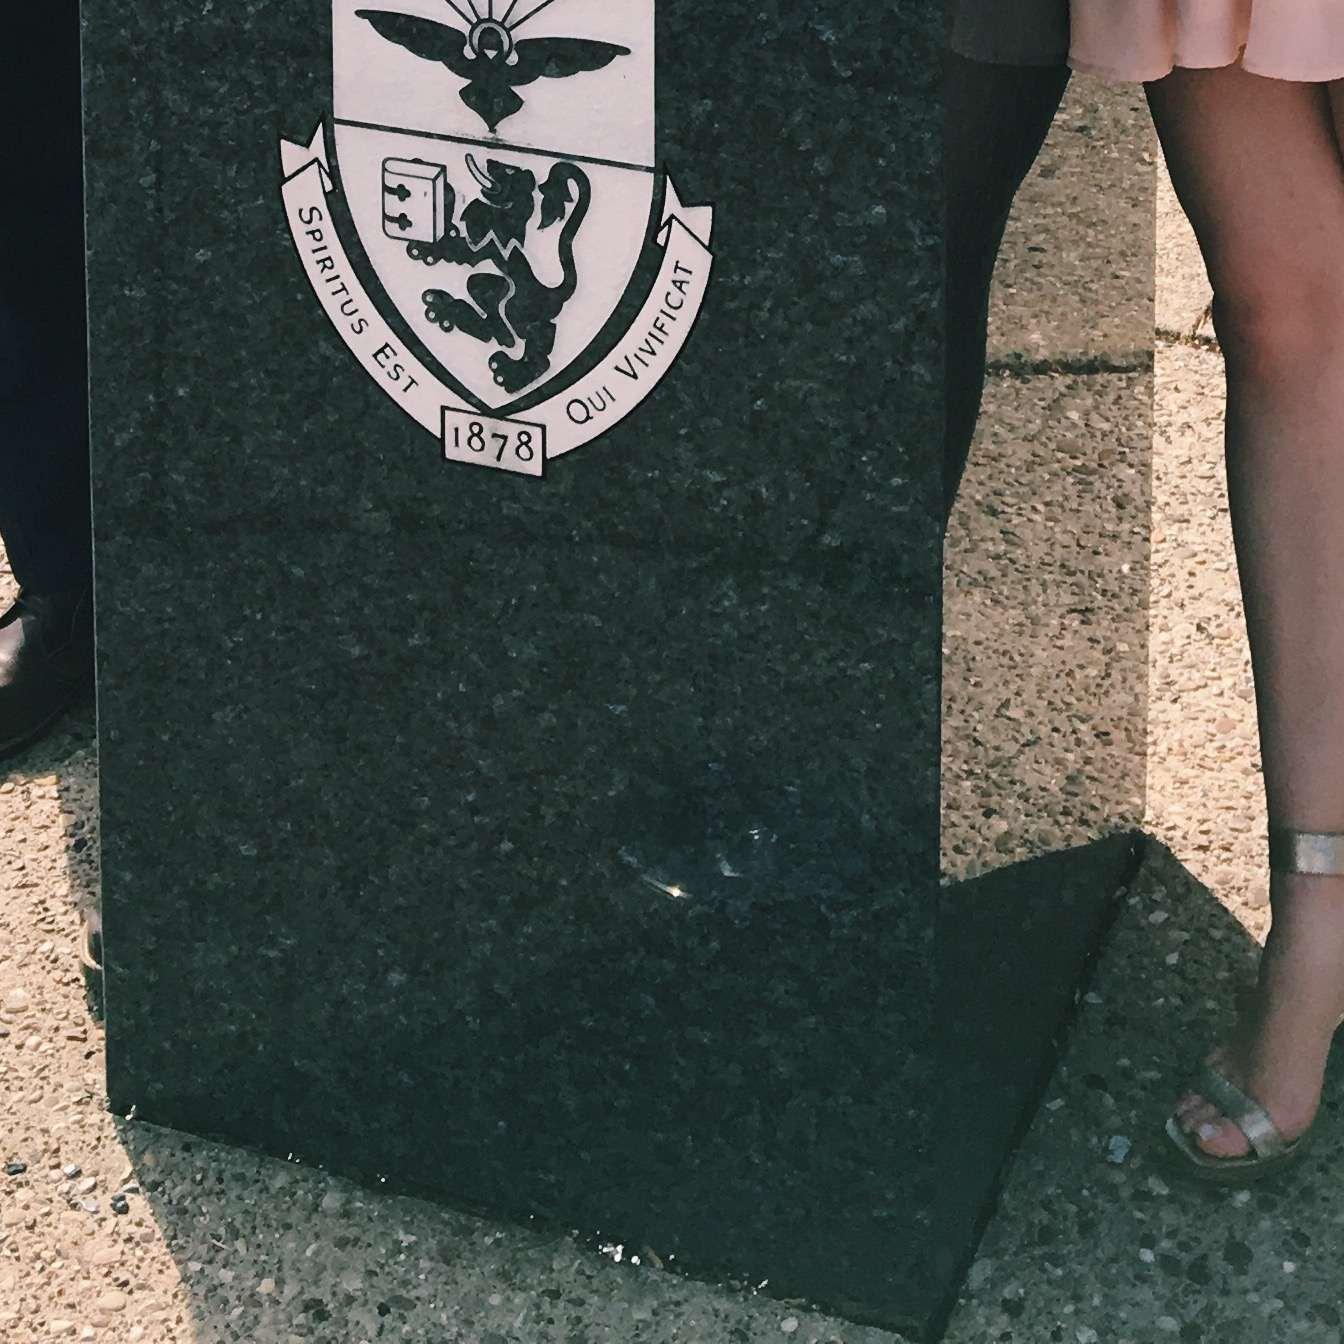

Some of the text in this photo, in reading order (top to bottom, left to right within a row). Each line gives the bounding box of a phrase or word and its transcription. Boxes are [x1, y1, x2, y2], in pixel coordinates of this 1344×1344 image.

[299, 206, 369, 335] SPIRITUS
[372, 342, 419, 393] EST
[454, 421, 534, 462] 1878
